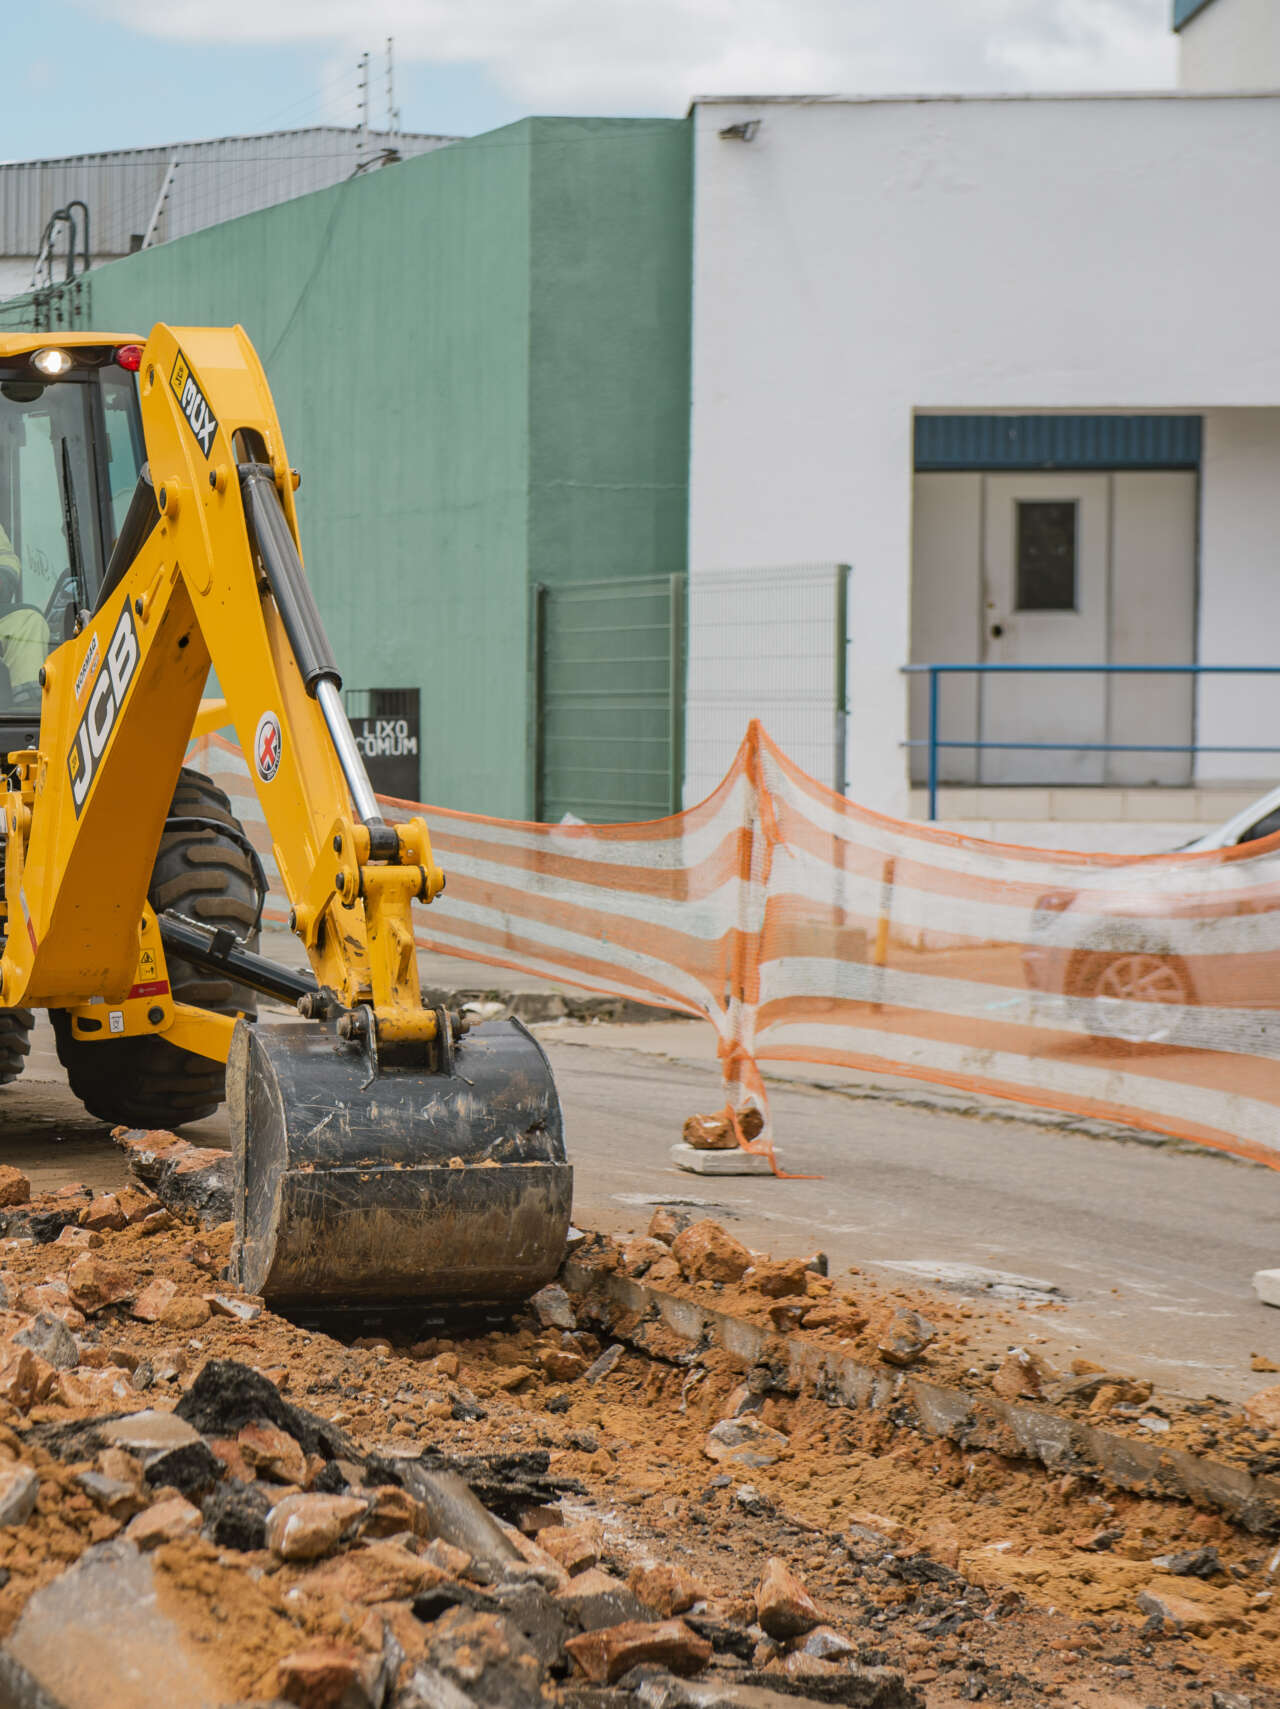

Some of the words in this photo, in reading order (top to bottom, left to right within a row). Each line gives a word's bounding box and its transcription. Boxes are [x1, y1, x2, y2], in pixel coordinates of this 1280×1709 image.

[75, 637, 96, 694] NORMAQ
[74, 612, 137, 806] JCB
[363, 720, 408, 738] LIXO
